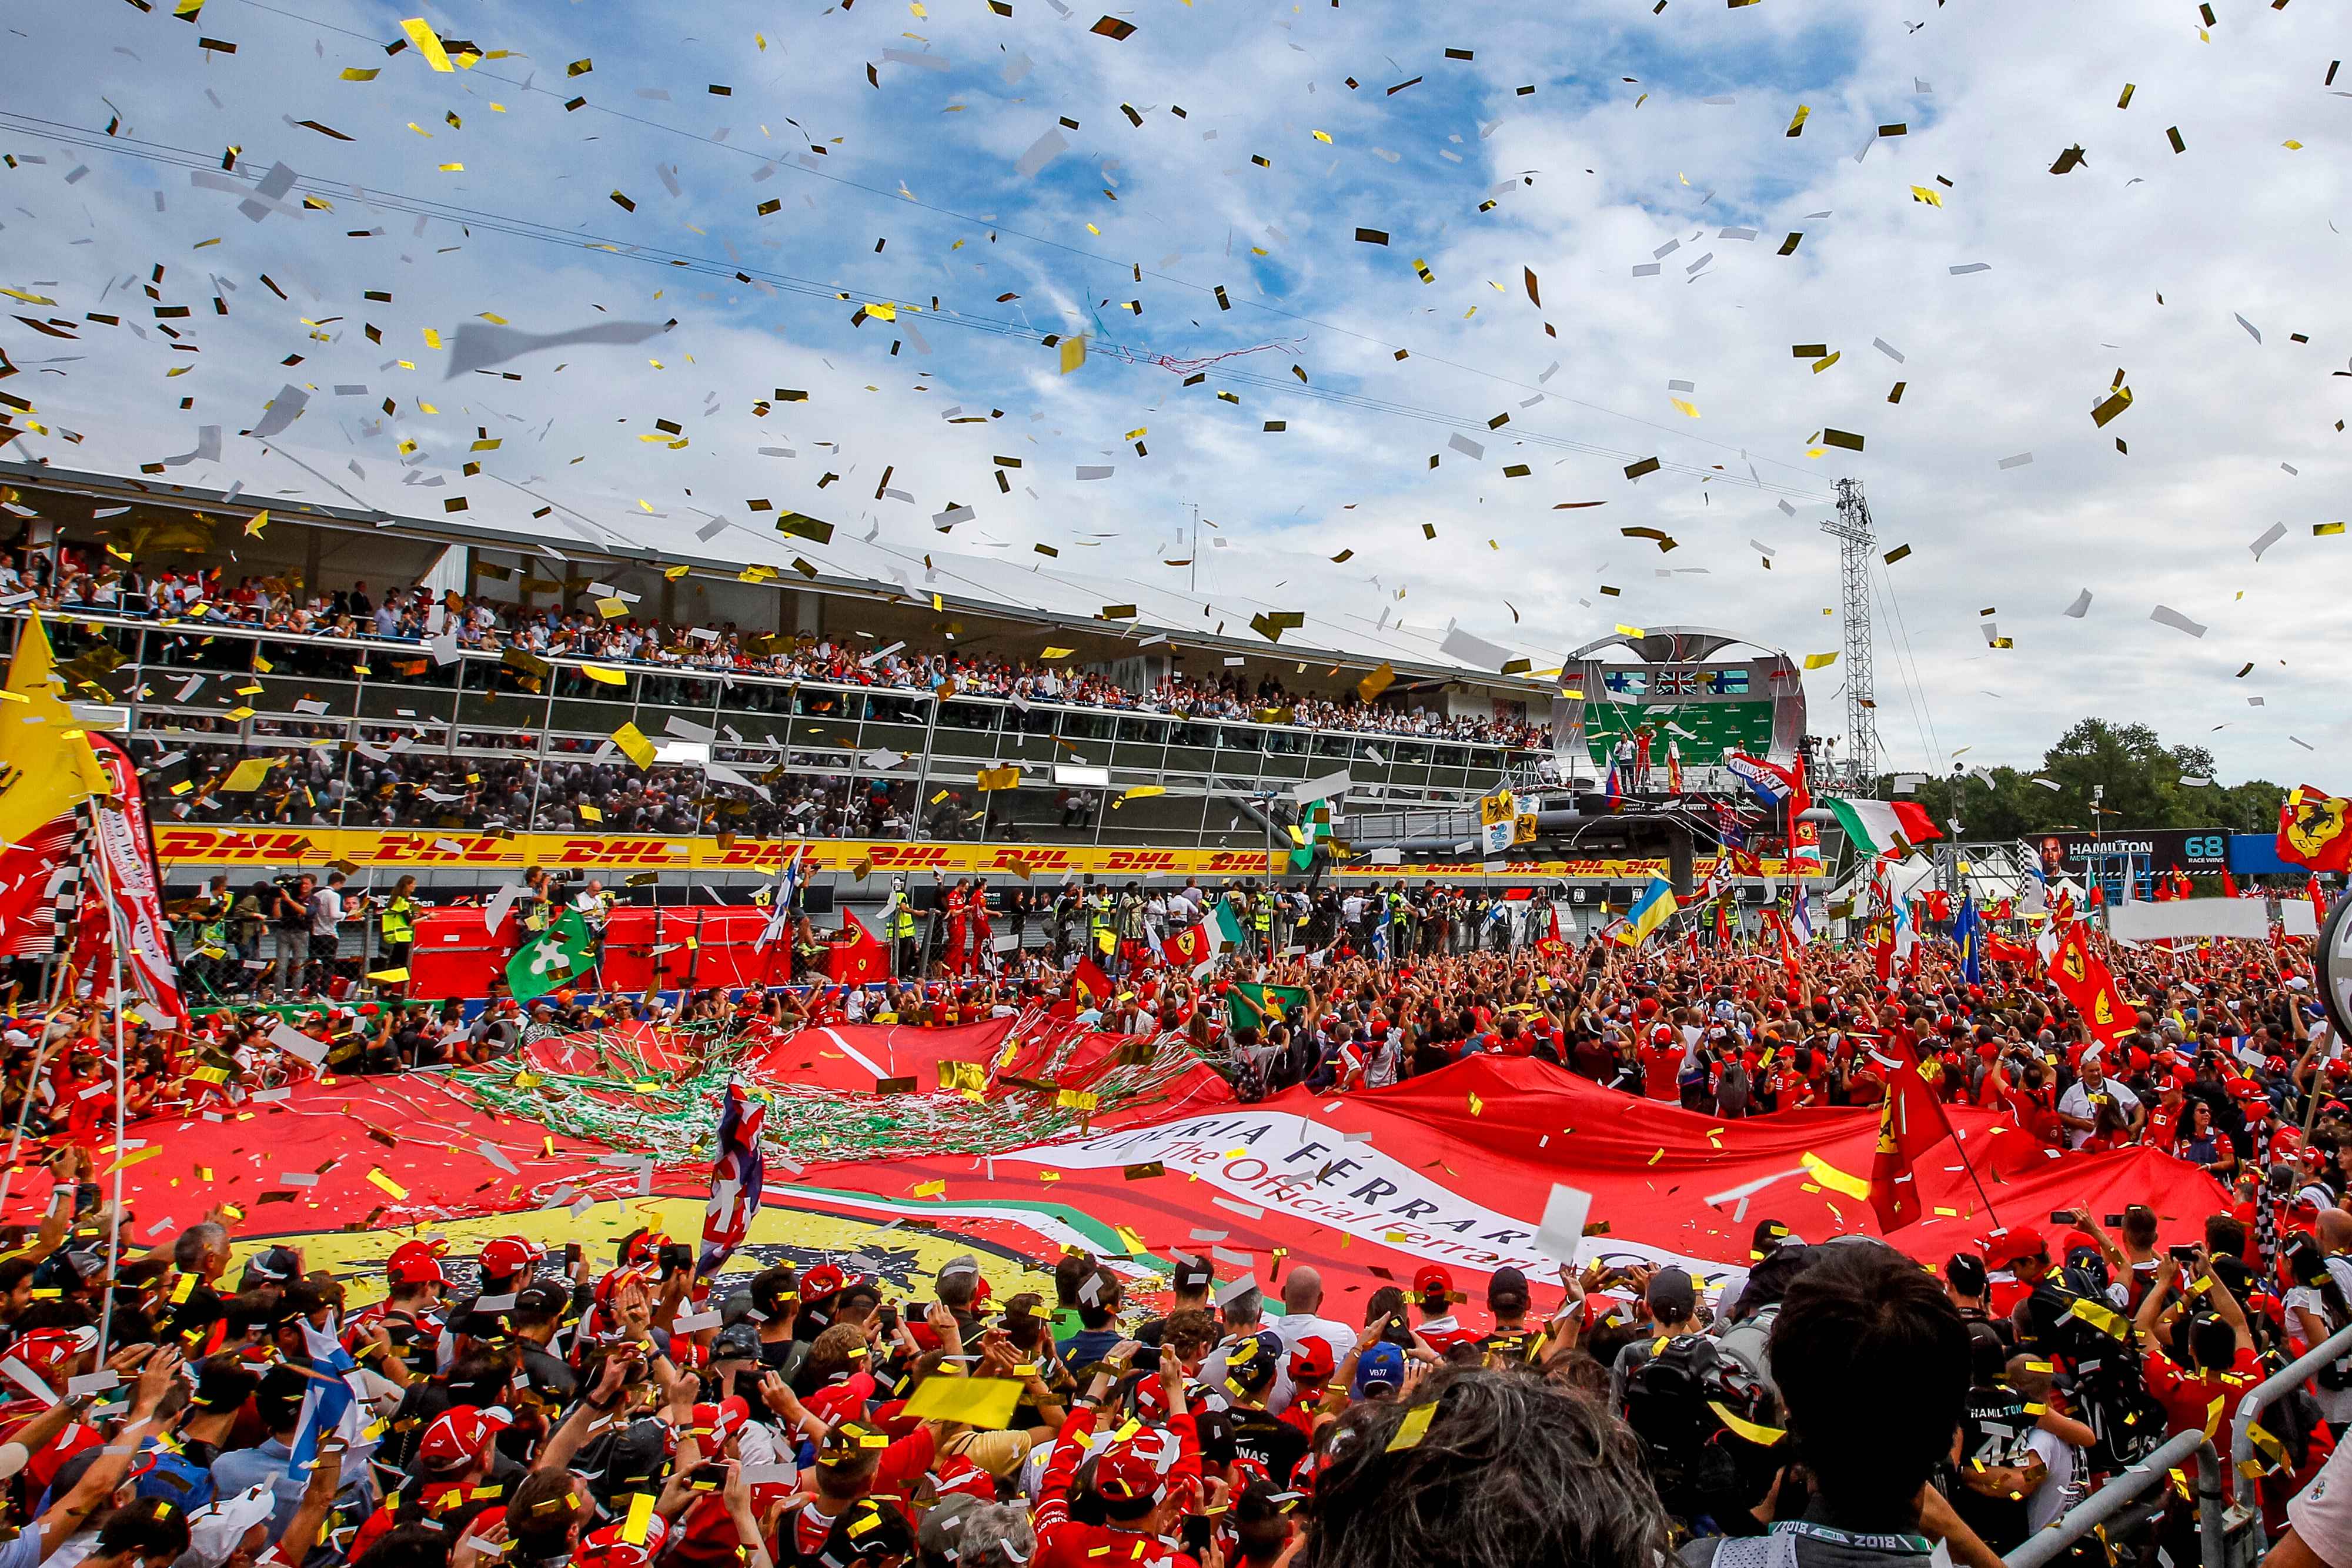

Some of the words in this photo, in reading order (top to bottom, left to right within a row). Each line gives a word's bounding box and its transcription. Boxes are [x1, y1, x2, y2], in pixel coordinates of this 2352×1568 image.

[159, 833, 305, 858] DHL
[373, 837, 503, 861] DHL
[559, 841, 670, 862] DHL
[720, 844, 818, 864] DHL
[2069, 842, 2153, 854] HAMILTON
[2185, 837, 2224, 857] 68
[867, 847, 952, 866] DHL
[991, 850, 1070, 868] DHL
[1105, 852, 1177, 870] DHL
[1208, 854, 1270, 871] DHL
[1563, 860, 1604, 874] DHL
[1574, 891, 1585, 900] FIA
[1051, 1121, 1273, 1151] UDERIA
[1284, 1142, 1536, 1250] FERRAR
[1151, 1141, 1219, 1165] The
[1222, 1158, 1382, 1223] Official
[1371, 1222, 1551, 1269] Ferrari
[1970, 1404, 2022, 1417] HAMILTON
[1235, 1445, 1269, 1465] NAS
[1037, 1517, 1068, 1534] UBLOT
[1782, 1521, 1809, 1534] 2018
[1855, 1535, 1896, 1548] 2018
